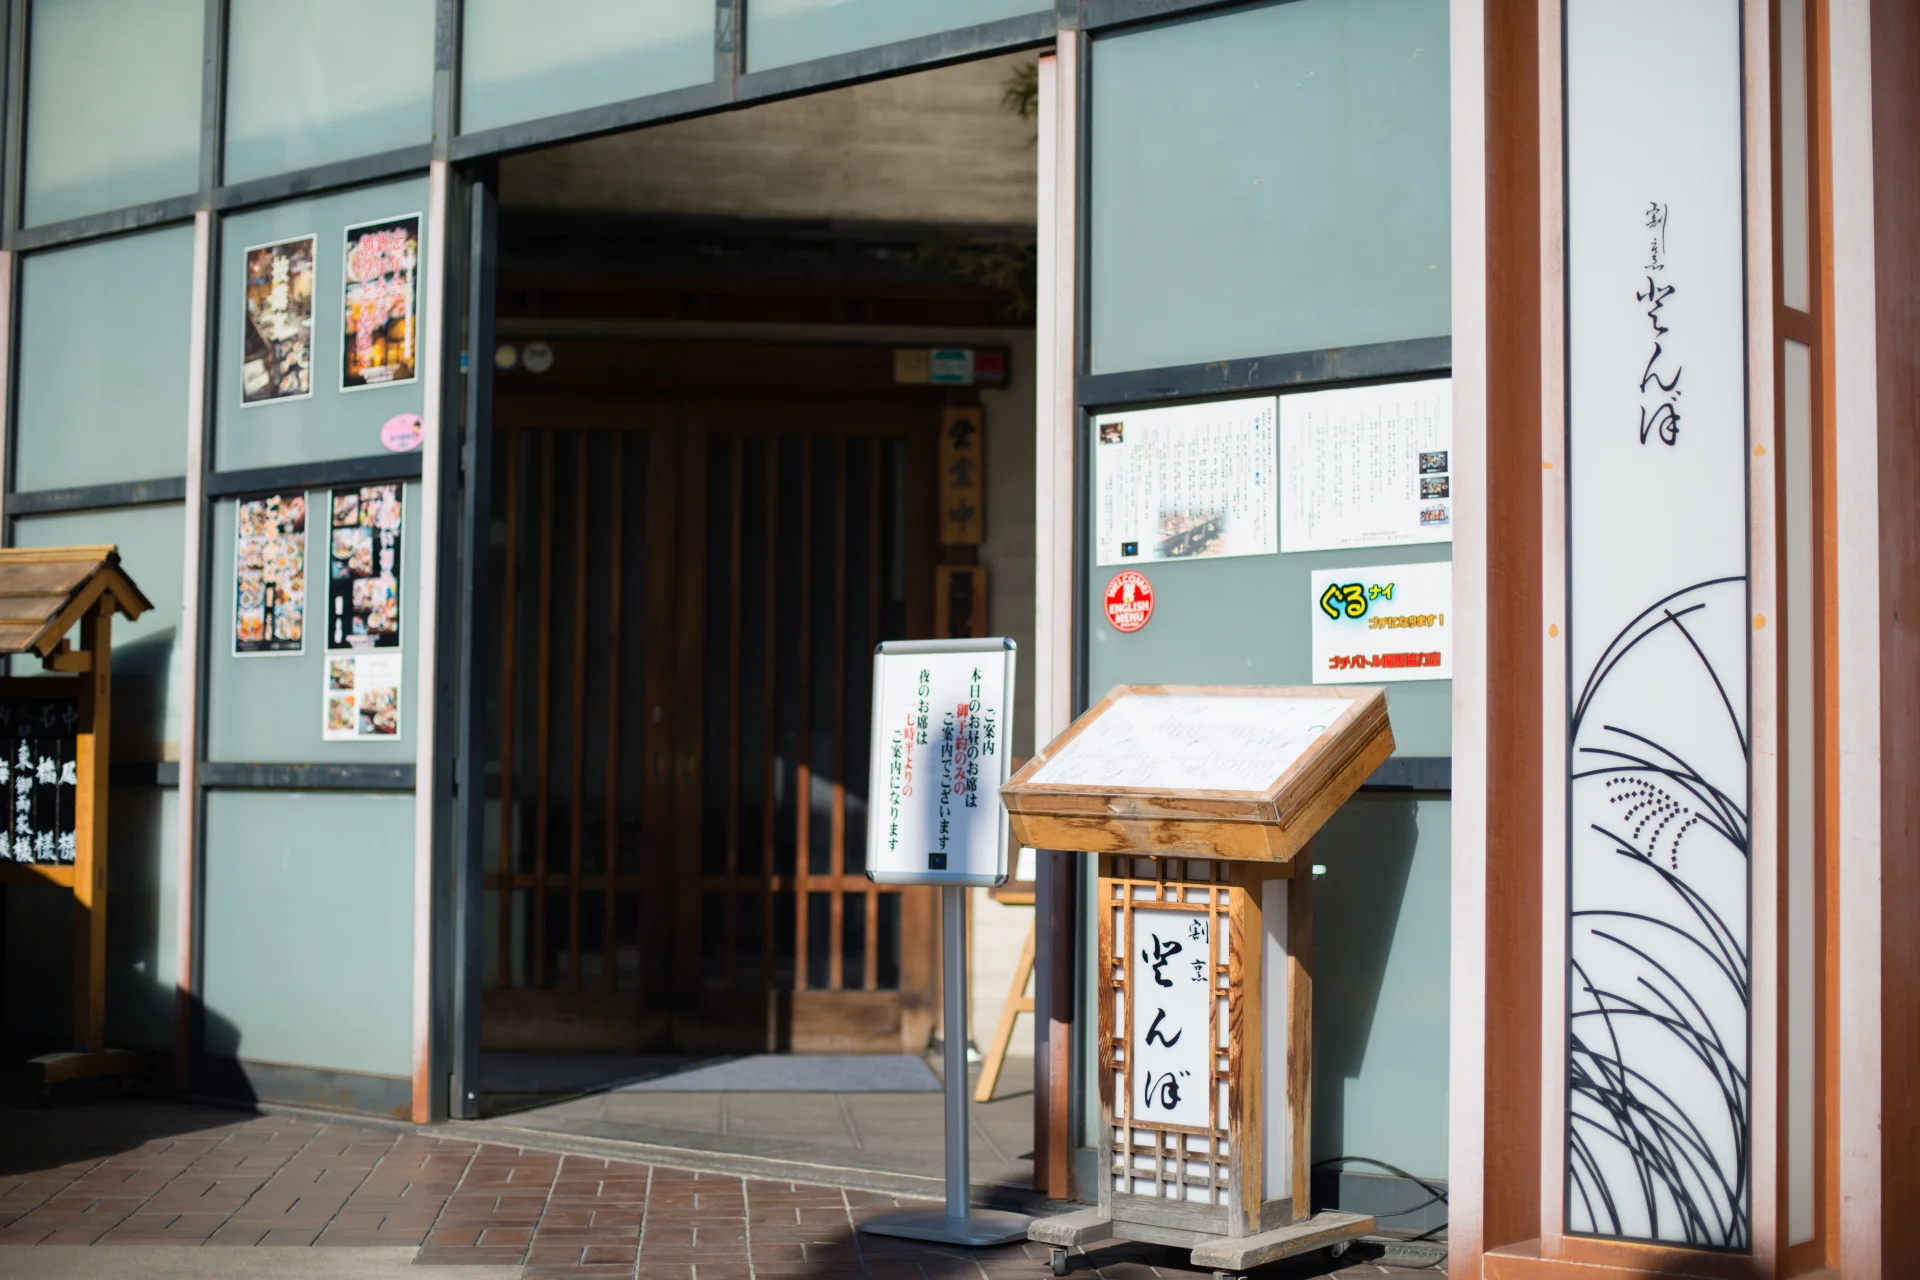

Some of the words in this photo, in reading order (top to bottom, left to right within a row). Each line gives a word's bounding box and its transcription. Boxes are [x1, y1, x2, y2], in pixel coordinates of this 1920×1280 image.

[947, 418, 976, 533] 営業中
[1109, 600, 1149, 615] ENGLISH
[1115, 612, 1144, 624] MENU
[1320, 583, 1394, 620] ぐるナイ
[916, 668, 930, 745] 夜のお席は
[965, 667, 982, 808] 本日のお昼のお席は
[982, 708, 996, 756] ご案内
[938, 712, 954, 850] ご案内でございます
[954, 703, 969, 795] 御予約のみの
[888, 729, 902, 852] ご案内になります
[1188, 918, 1209, 982] 割烹
